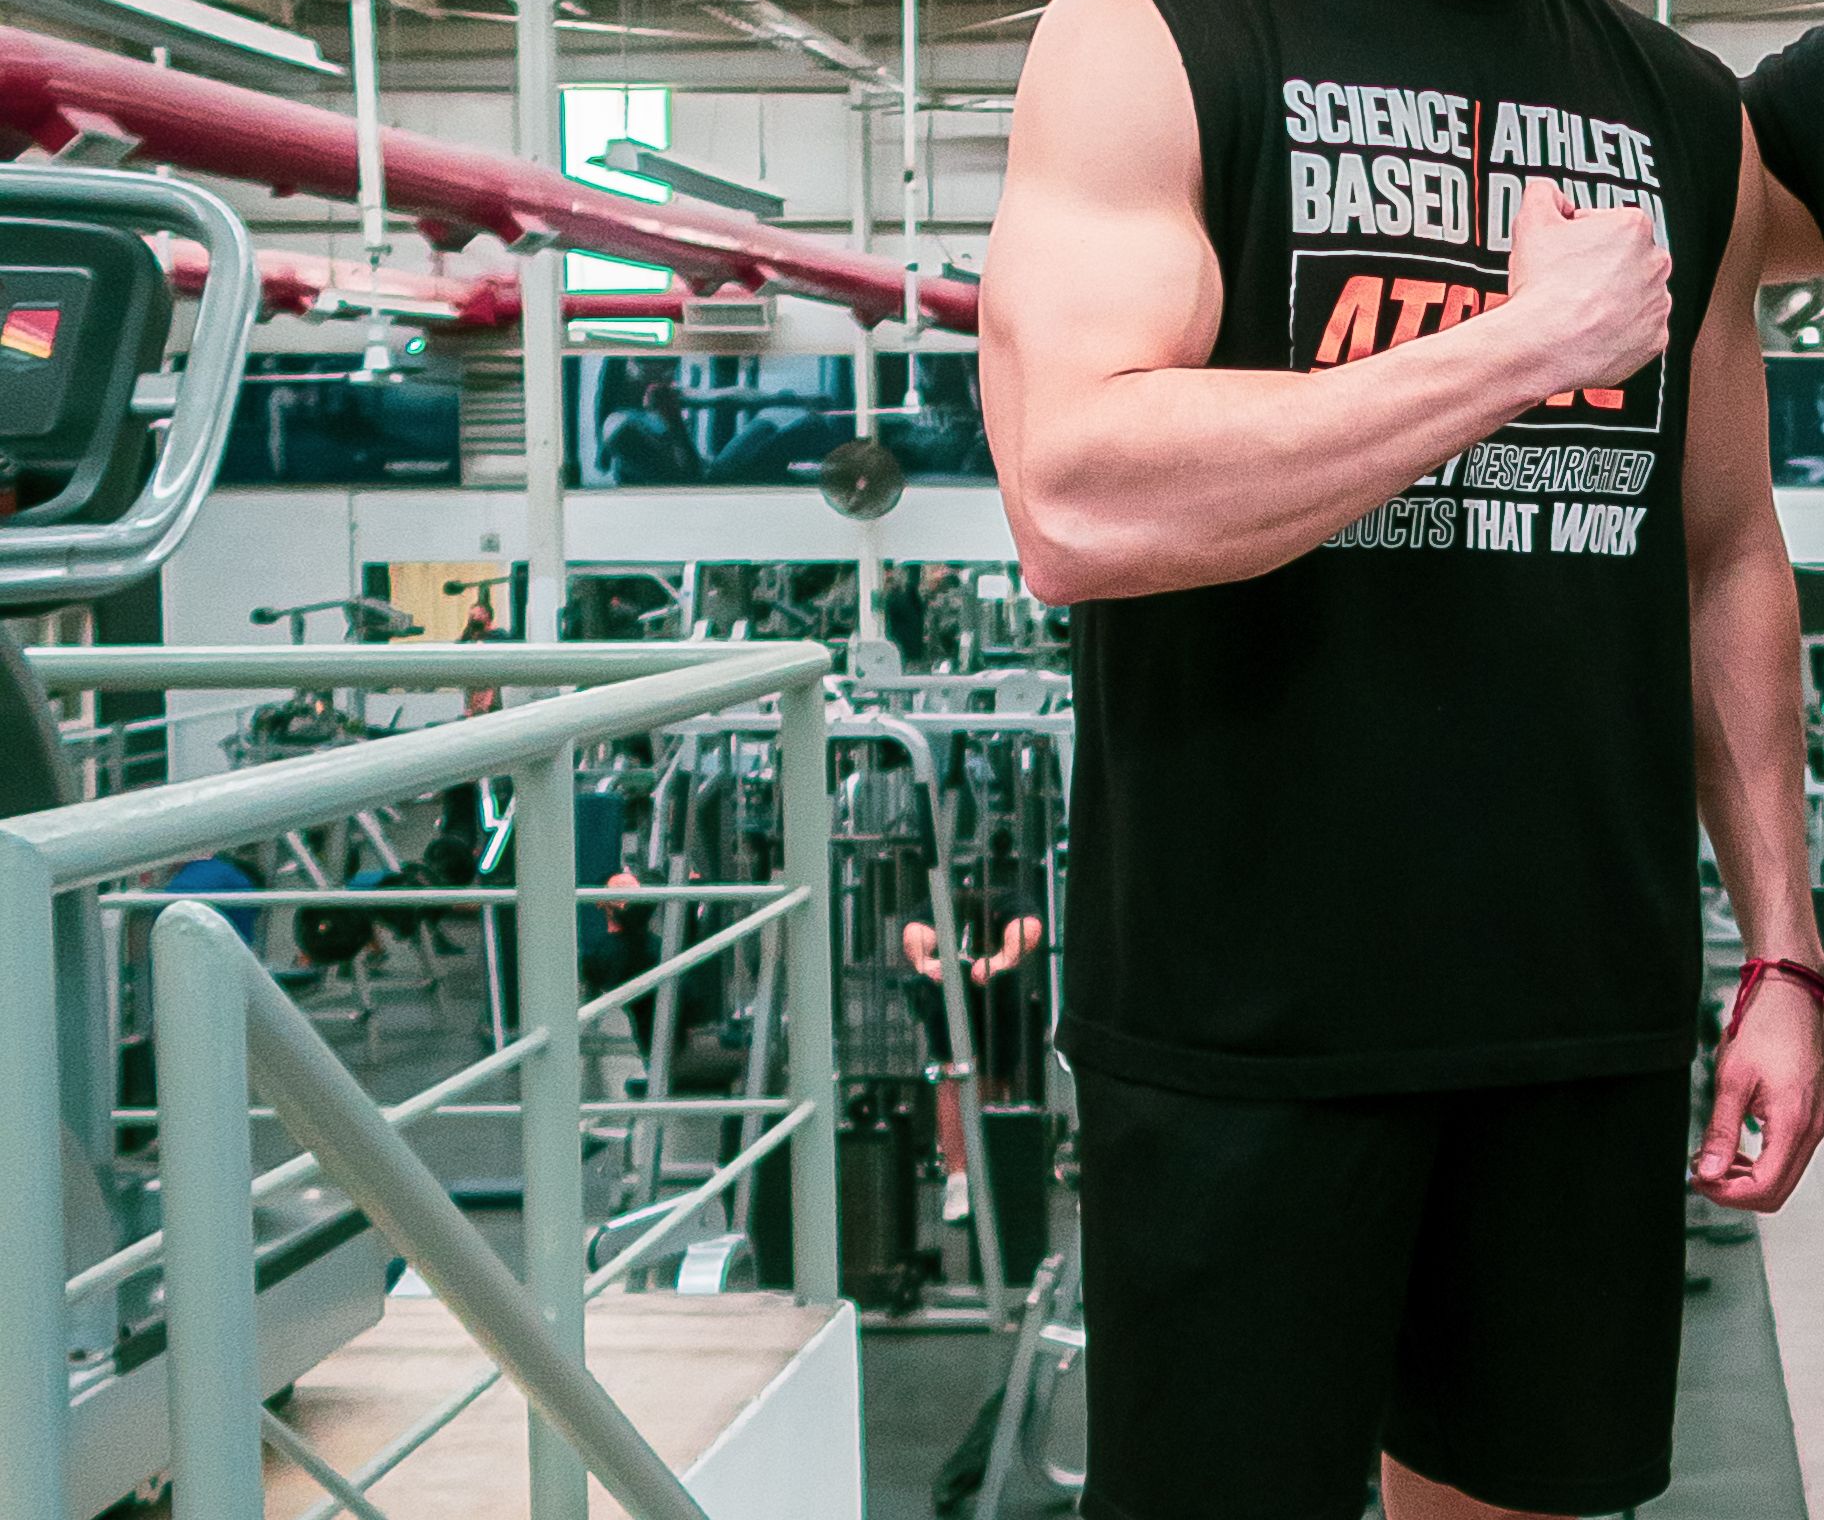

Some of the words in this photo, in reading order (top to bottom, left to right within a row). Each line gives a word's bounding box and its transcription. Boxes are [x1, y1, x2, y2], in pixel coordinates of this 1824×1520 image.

[1282, 79, 1472, 159] SCIENCE
[1489, 101, 1660, 188] ATHLETE
[1291, 150, 1469, 243] BASED
[1463, 442, 1655, 495] RESEARCHED
[1463, 498, 1539, 553] THAT
[1550, 502, 1647, 556] WORK
